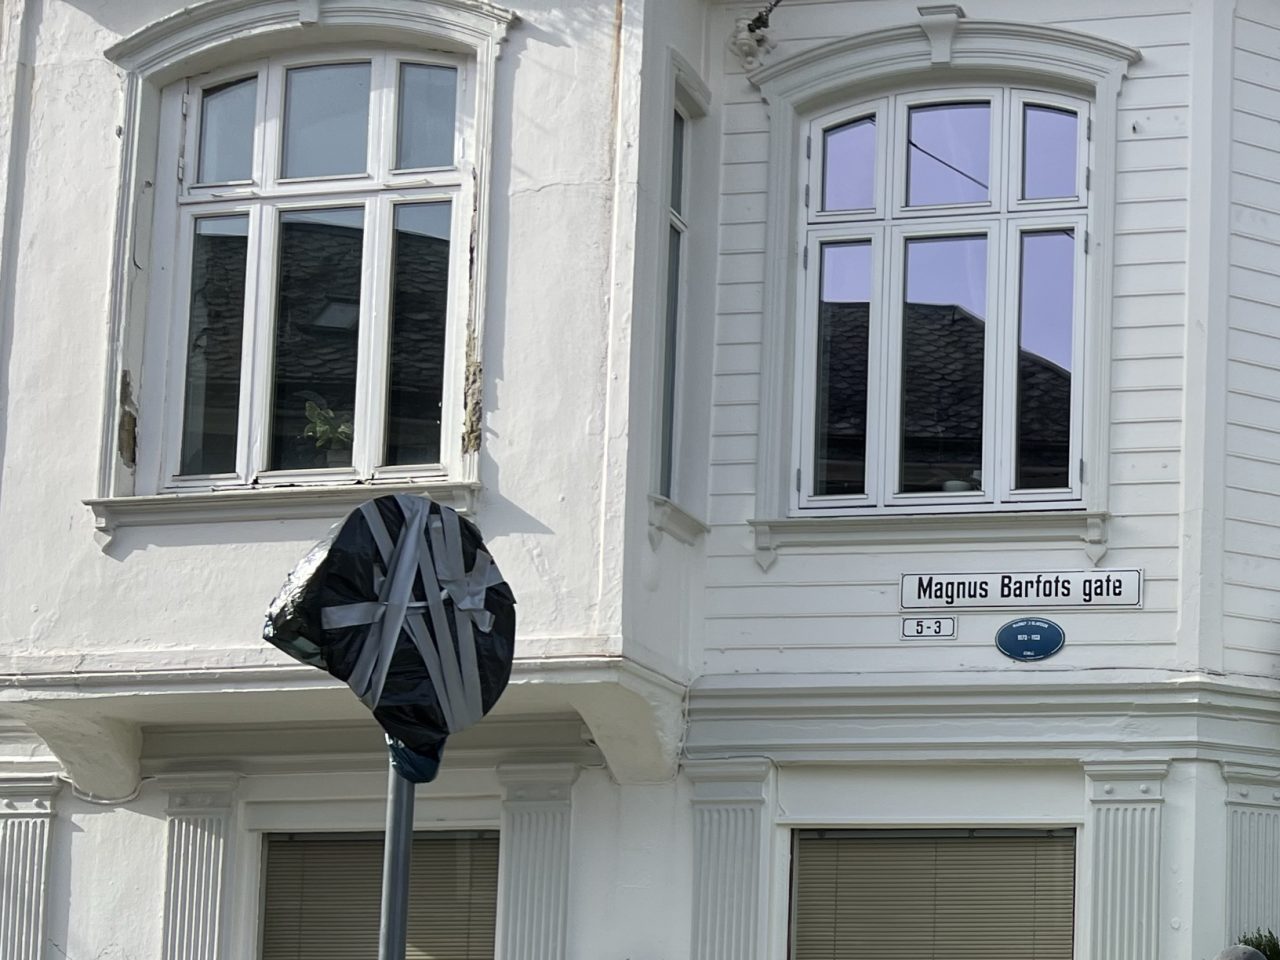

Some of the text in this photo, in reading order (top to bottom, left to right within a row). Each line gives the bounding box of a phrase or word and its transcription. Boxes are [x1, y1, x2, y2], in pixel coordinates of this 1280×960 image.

[917, 574, 1123, 605] Magnus Barfots gate
